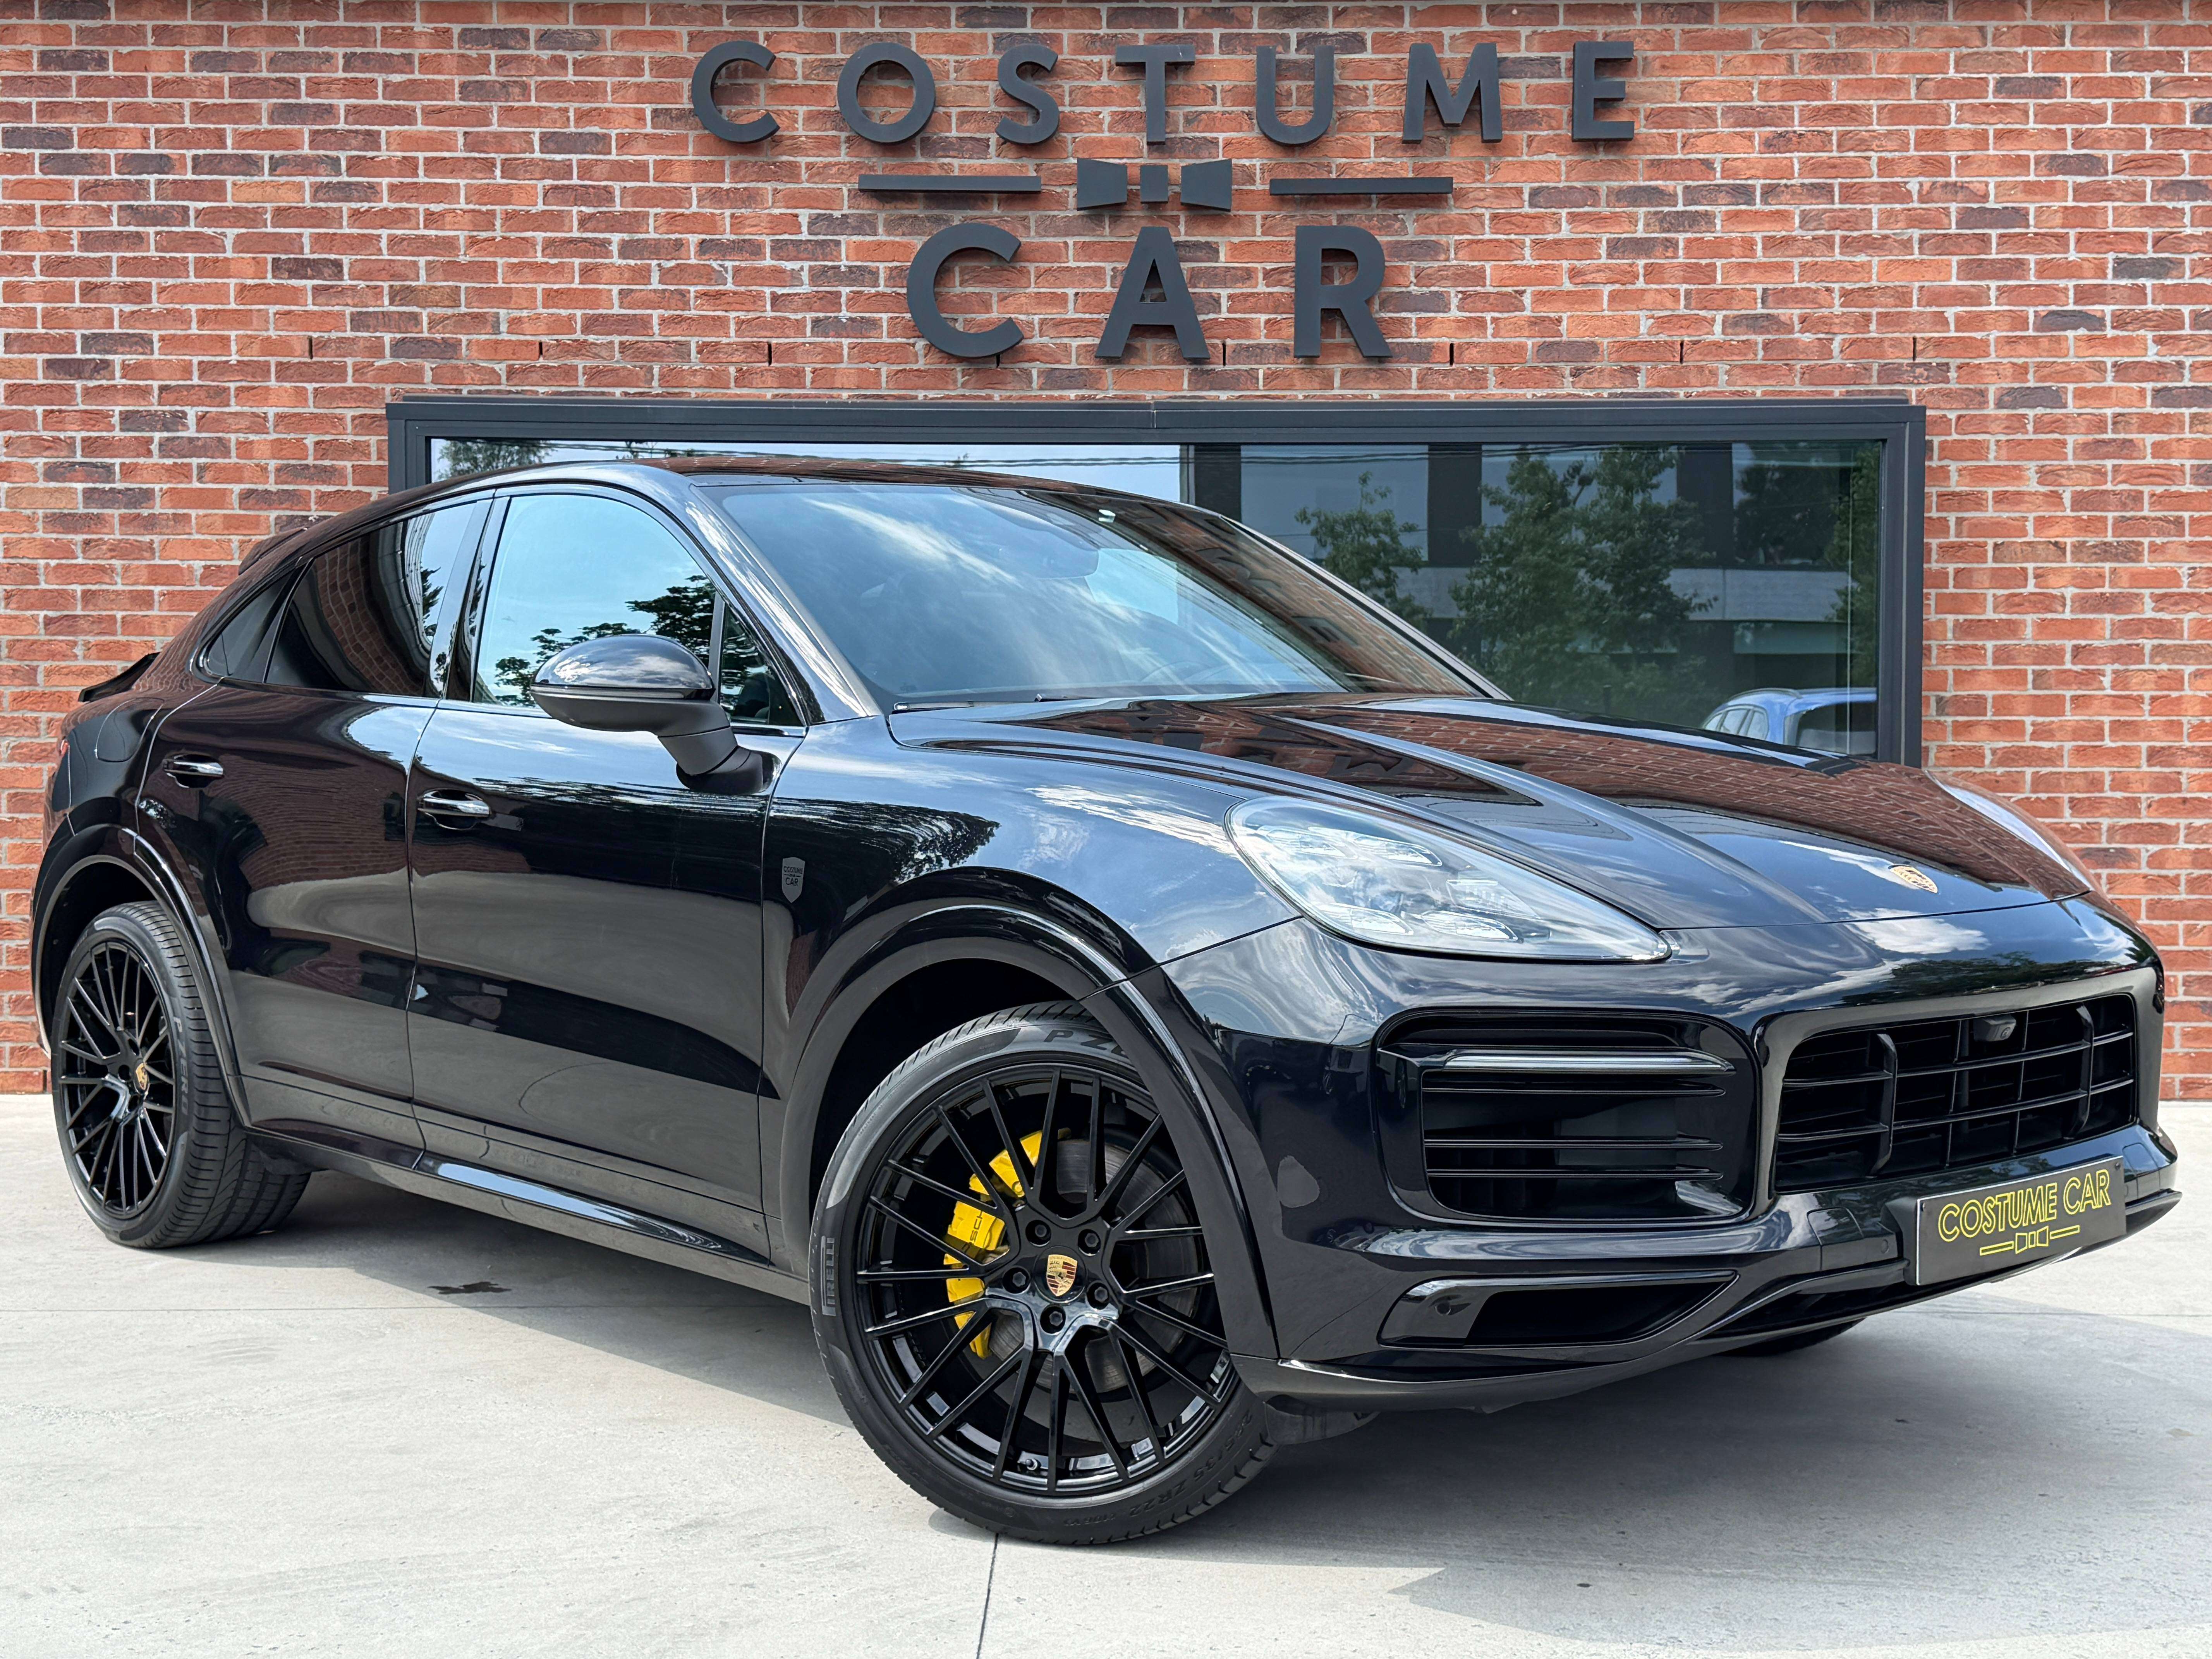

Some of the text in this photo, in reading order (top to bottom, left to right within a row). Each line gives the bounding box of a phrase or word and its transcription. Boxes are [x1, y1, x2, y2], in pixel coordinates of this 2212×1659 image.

[690, 40, 1635, 146] COSTUME
[906, 223, 1393, 359] CAR
[785, 877, 799, 886] CAR
[178, 1039, 189, 1116] ZERO
[1938, 1169, 2111, 1243] COSTUME CAR
[820, 1235, 836, 1317] PIRELLI
[1129, 1479, 1187, 1517] ZR22
